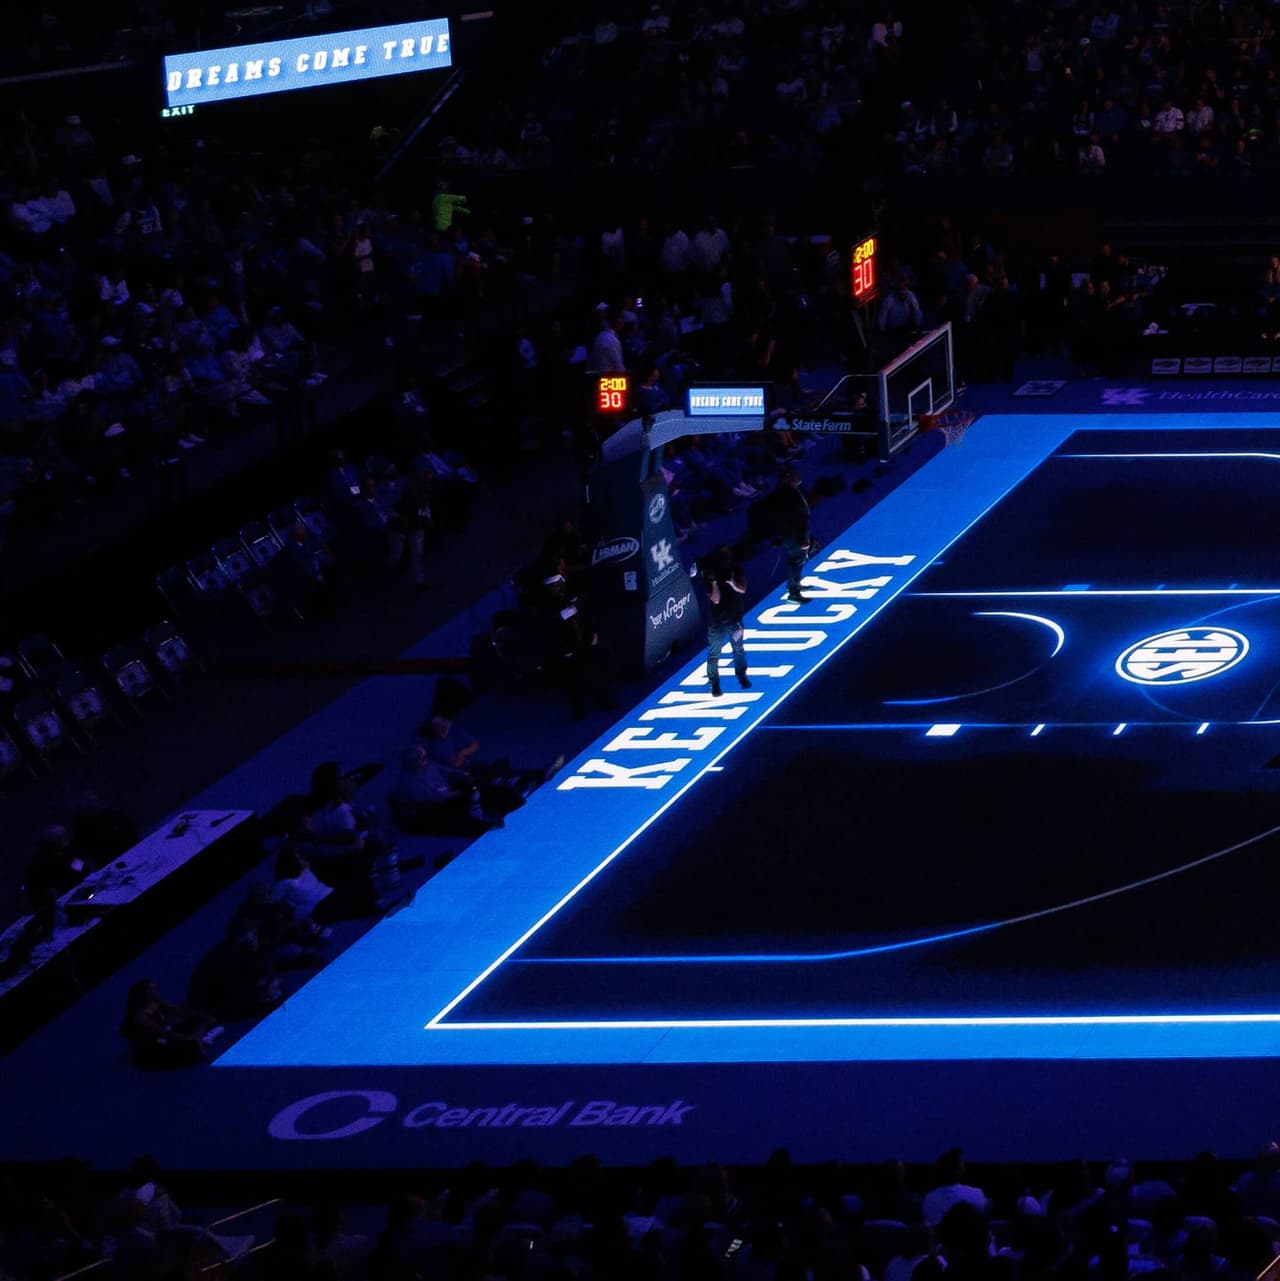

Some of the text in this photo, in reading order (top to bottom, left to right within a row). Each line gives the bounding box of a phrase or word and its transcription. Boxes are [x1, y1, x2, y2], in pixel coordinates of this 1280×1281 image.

[166, 33, 450, 92] DREAMS COME TRUE
[600, 378, 627, 391] 2:00
[601, 392, 622, 408] 30
[556, 549, 917, 791] KENTUCKY
[1126, 631, 1239, 680] SEC
[402, 1100, 697, 1128] Central Bank
